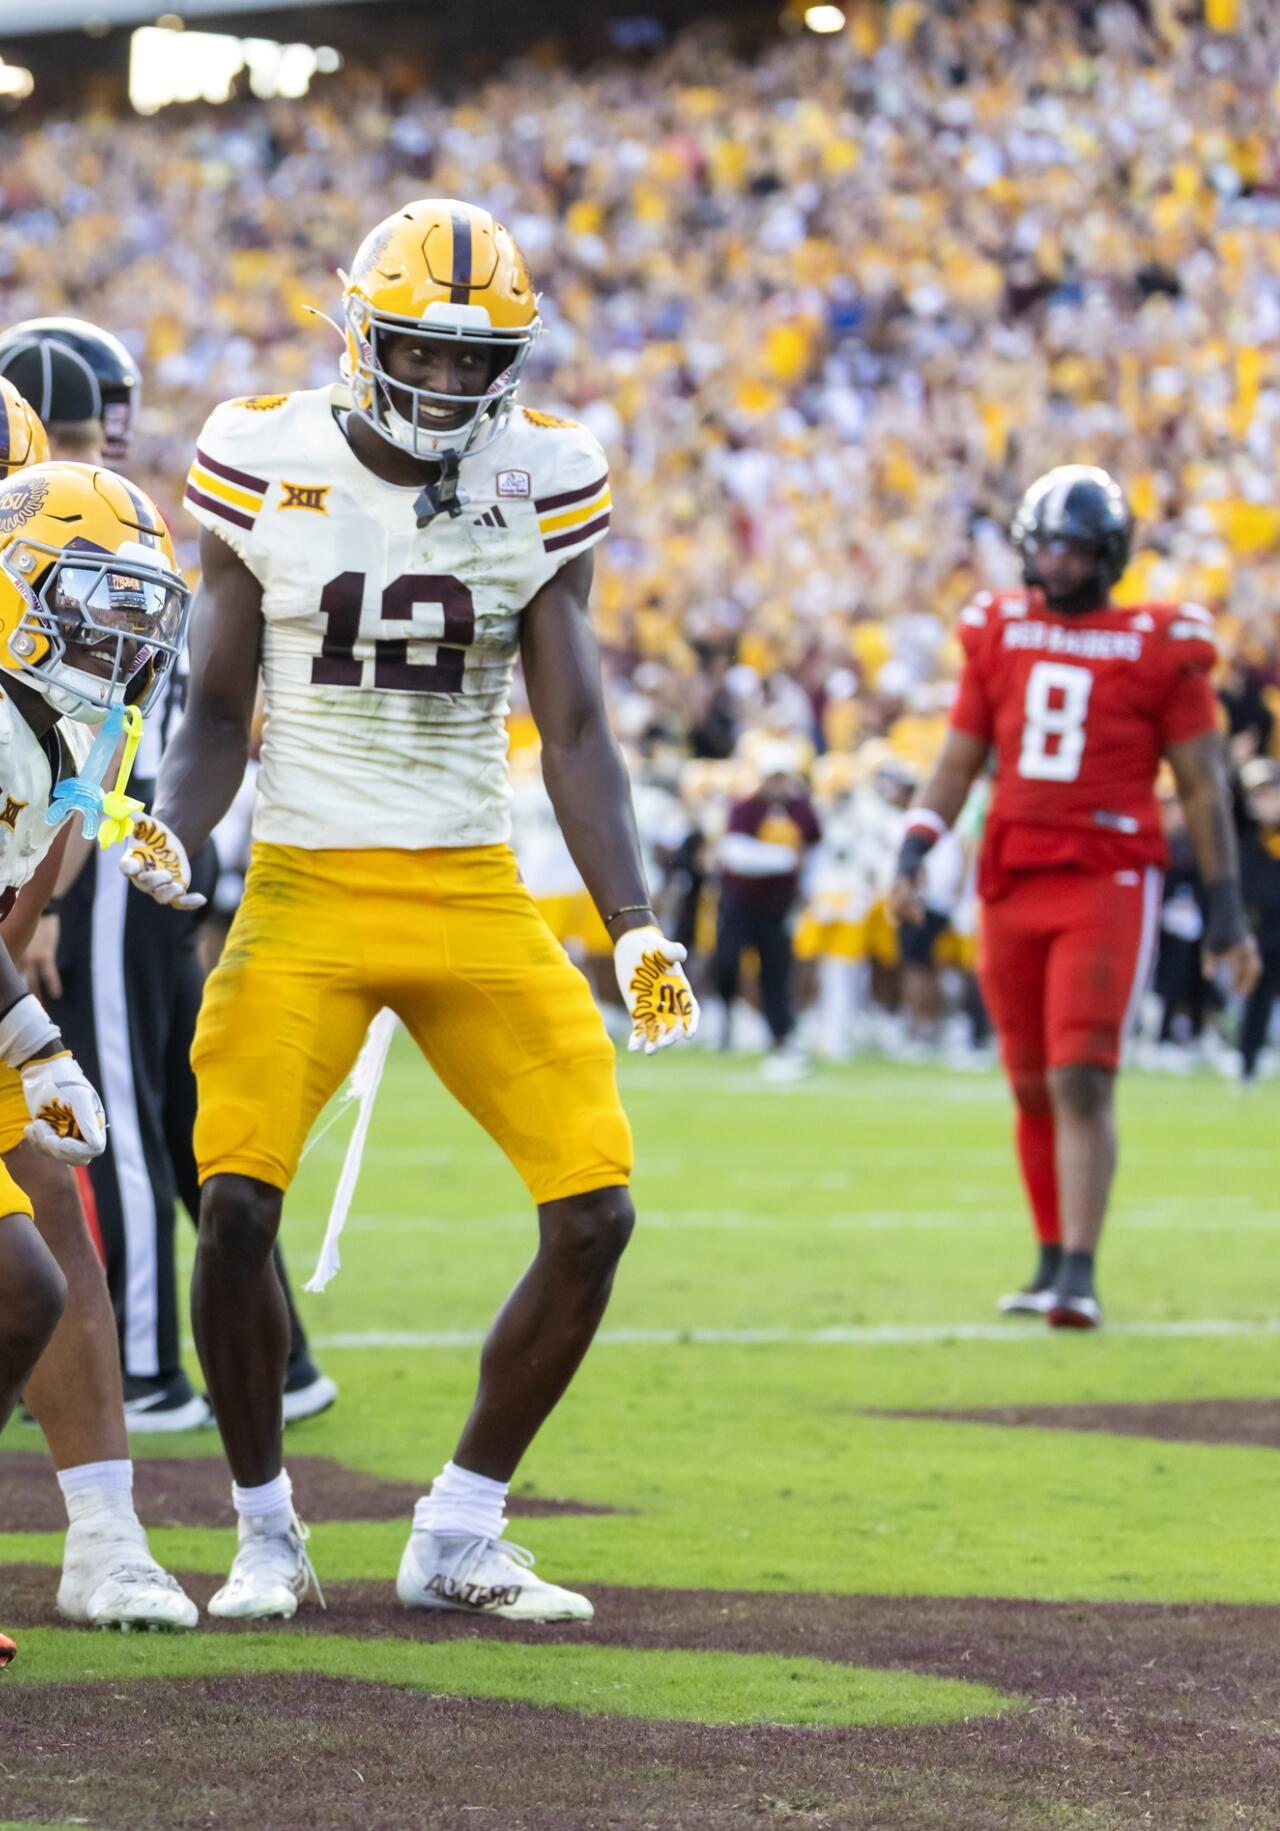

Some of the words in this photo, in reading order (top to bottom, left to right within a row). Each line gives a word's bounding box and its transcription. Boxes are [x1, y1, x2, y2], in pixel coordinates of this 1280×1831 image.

[279, 482, 329, 514] XII
[311, 571, 475, 694] 12
[1018, 661, 1094, 783] 8
[423, 1573, 523, 1606] ADZERO
